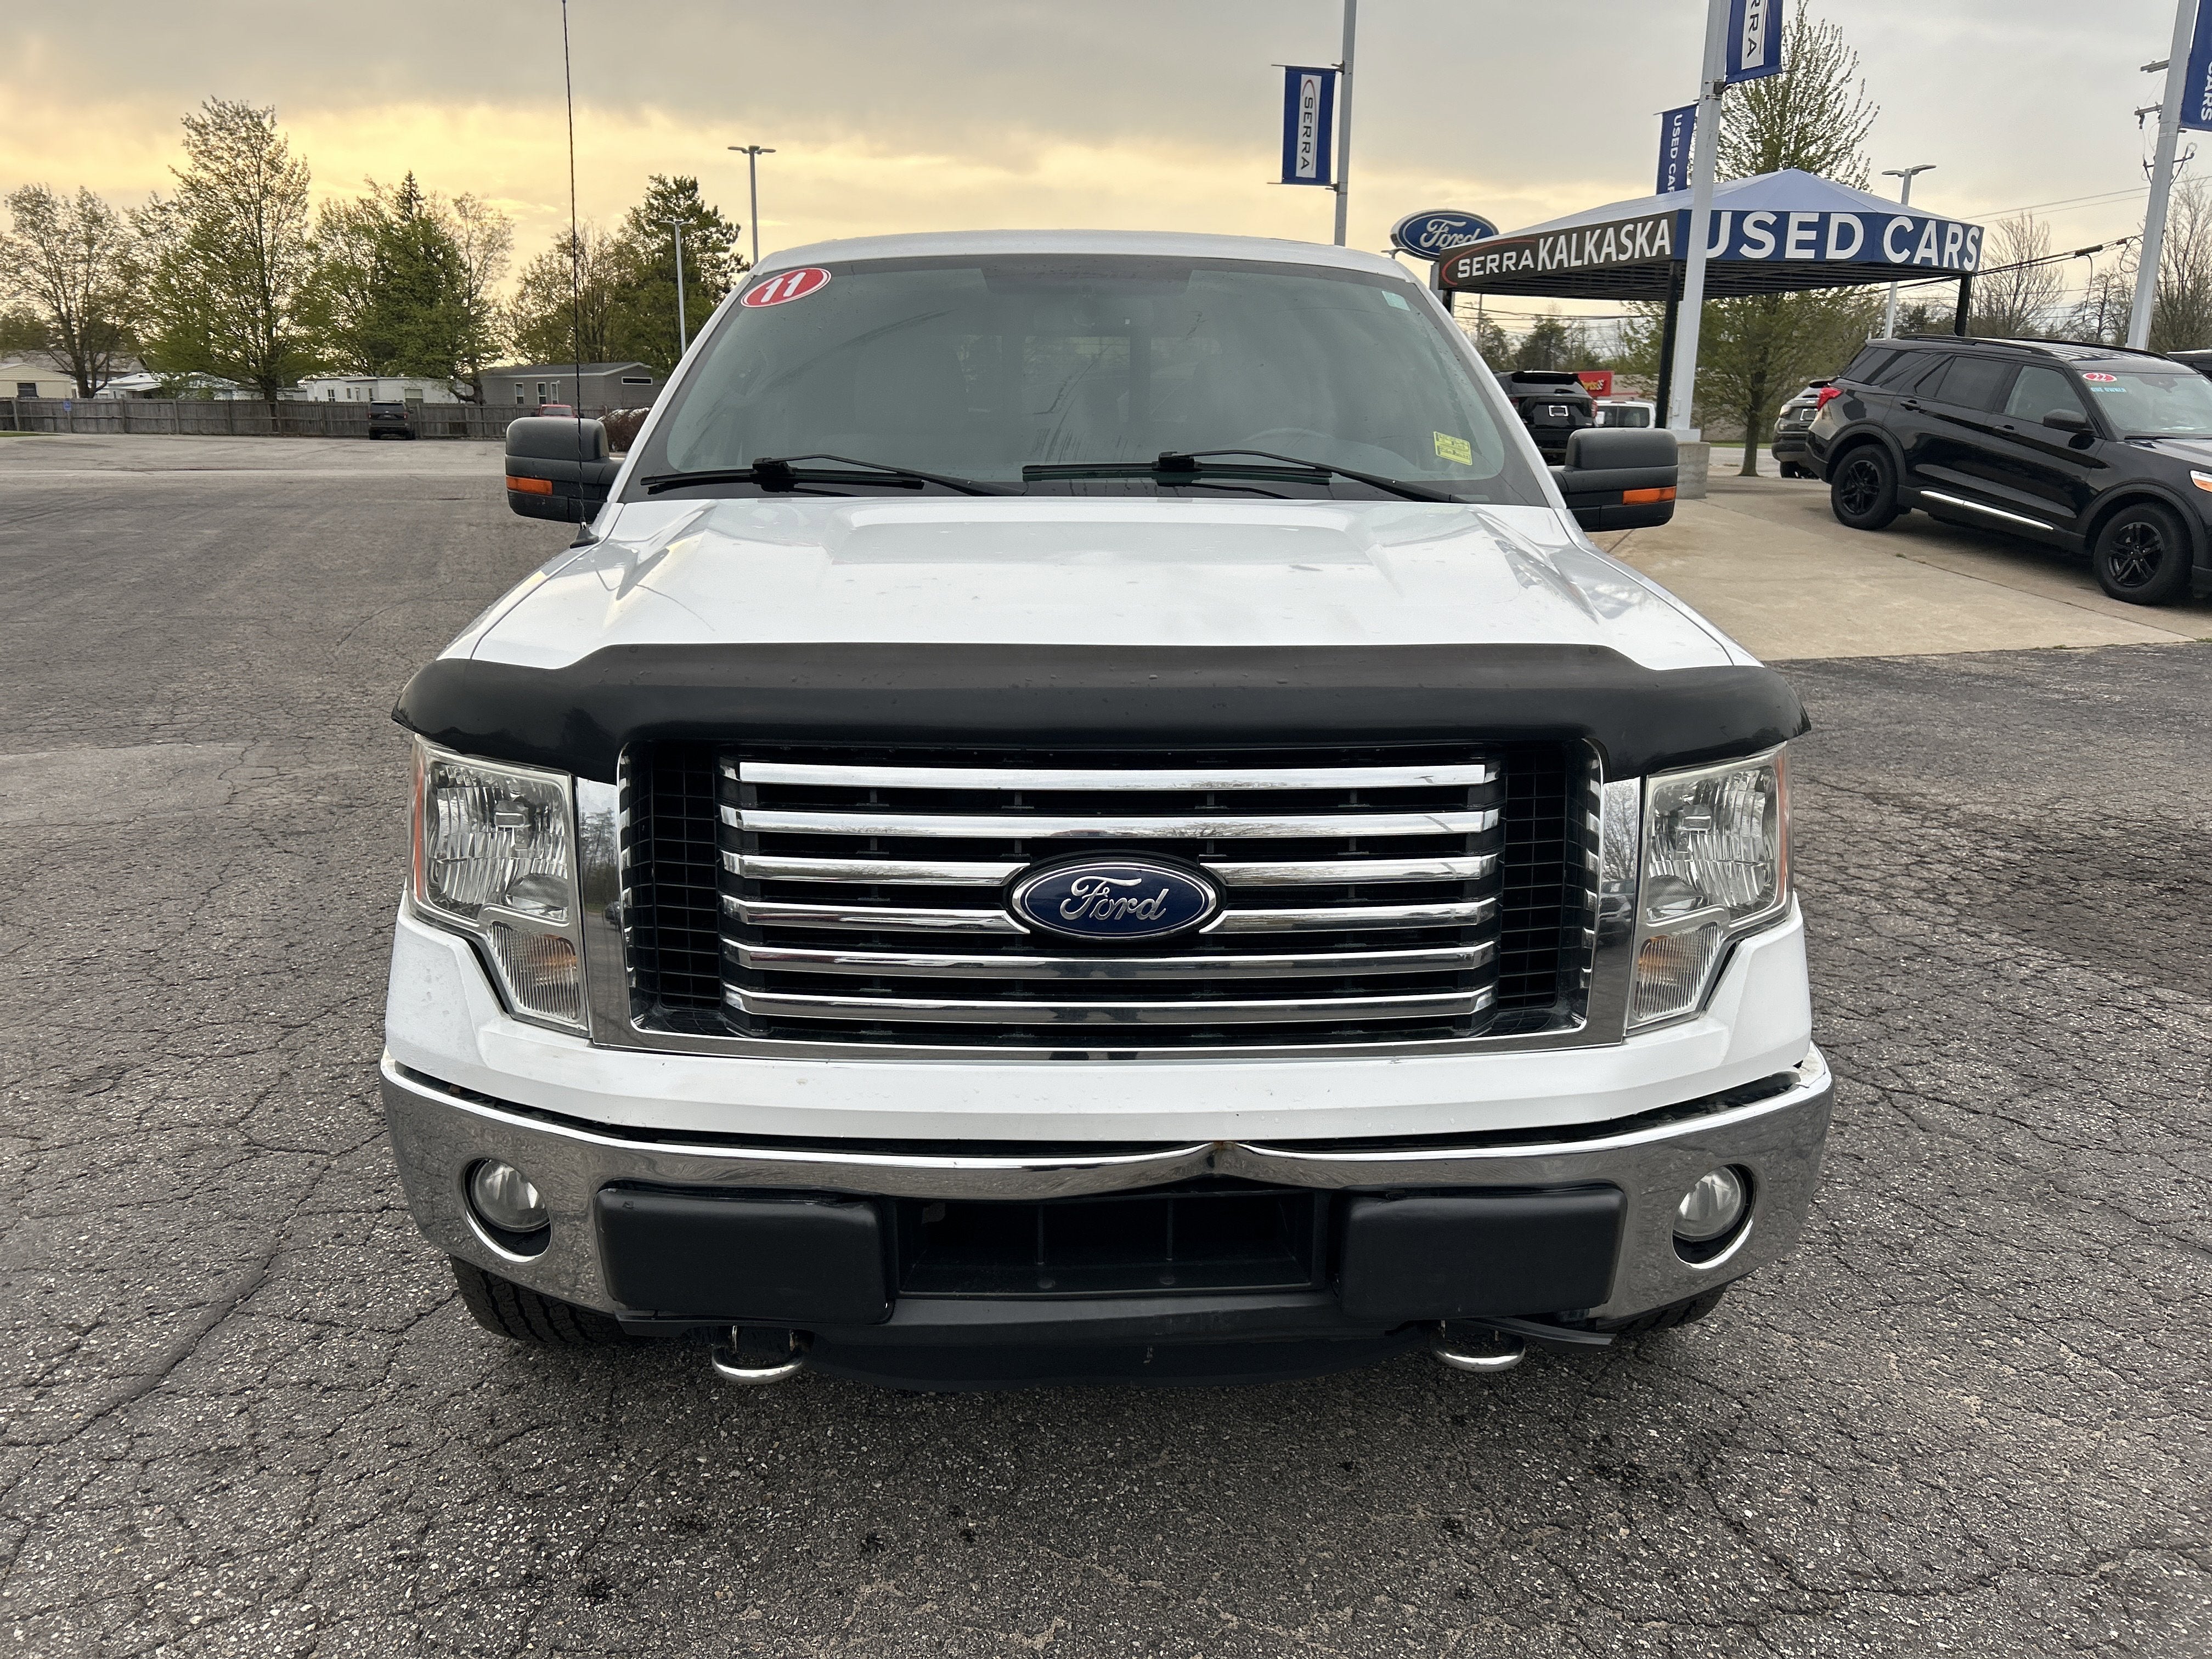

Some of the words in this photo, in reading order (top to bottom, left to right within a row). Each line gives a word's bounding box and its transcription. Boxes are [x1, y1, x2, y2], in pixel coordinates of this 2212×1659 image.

[1301, 97, 1313, 170] SERRA
[1670, 114, 1683, 159] USED
[1420, 219, 1481, 248] Ford
[1457, 249, 1534, 278] SERRA
[1537, 218, 1672, 271] KALKASKA
[1883, 216, 1980, 272] CARS
[760, 272, 806, 303] 11
[1059, 876, 1169, 921] Ford
